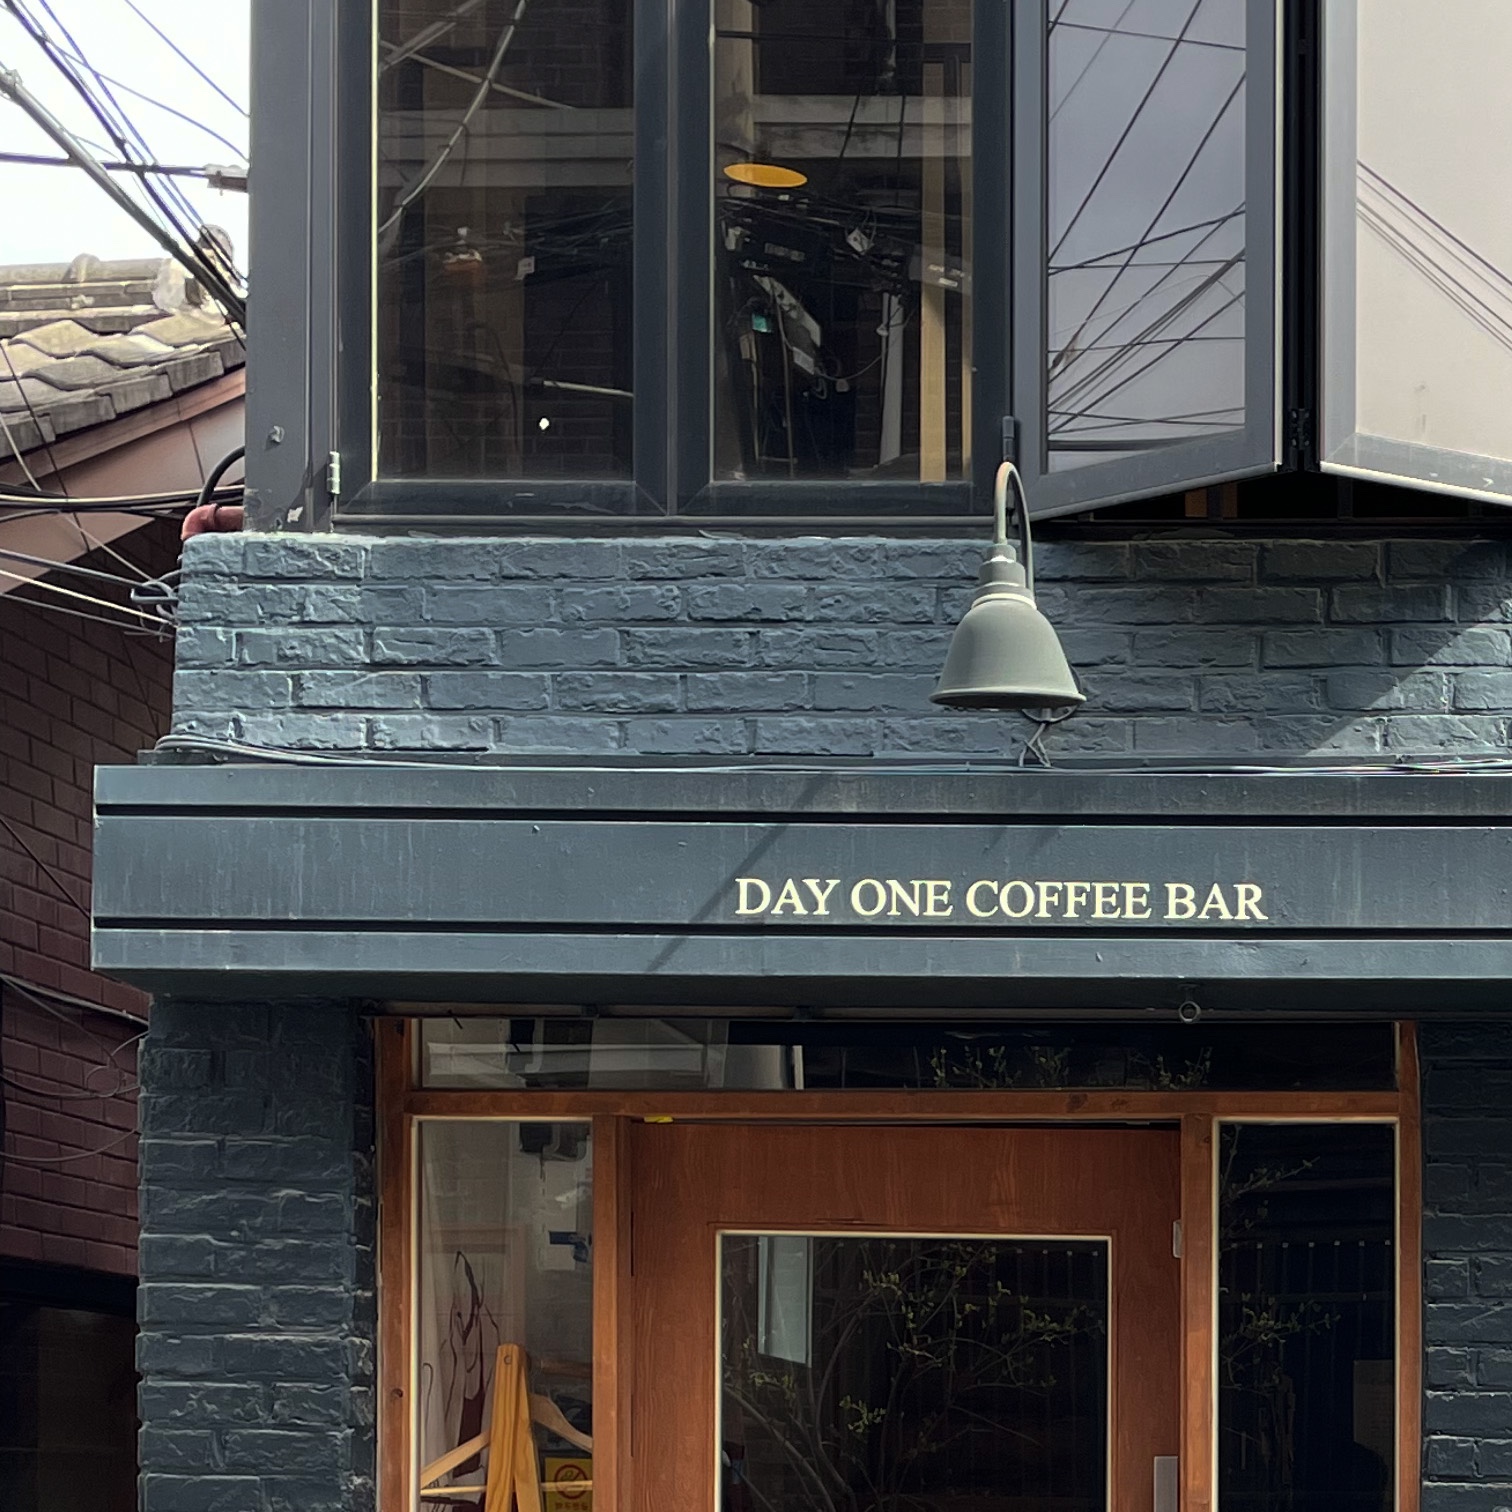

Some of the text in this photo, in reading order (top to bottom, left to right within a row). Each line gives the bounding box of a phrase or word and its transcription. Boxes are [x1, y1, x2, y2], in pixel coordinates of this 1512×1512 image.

[735, 878, 1268, 921] DAY ONE COFFEE BAR
